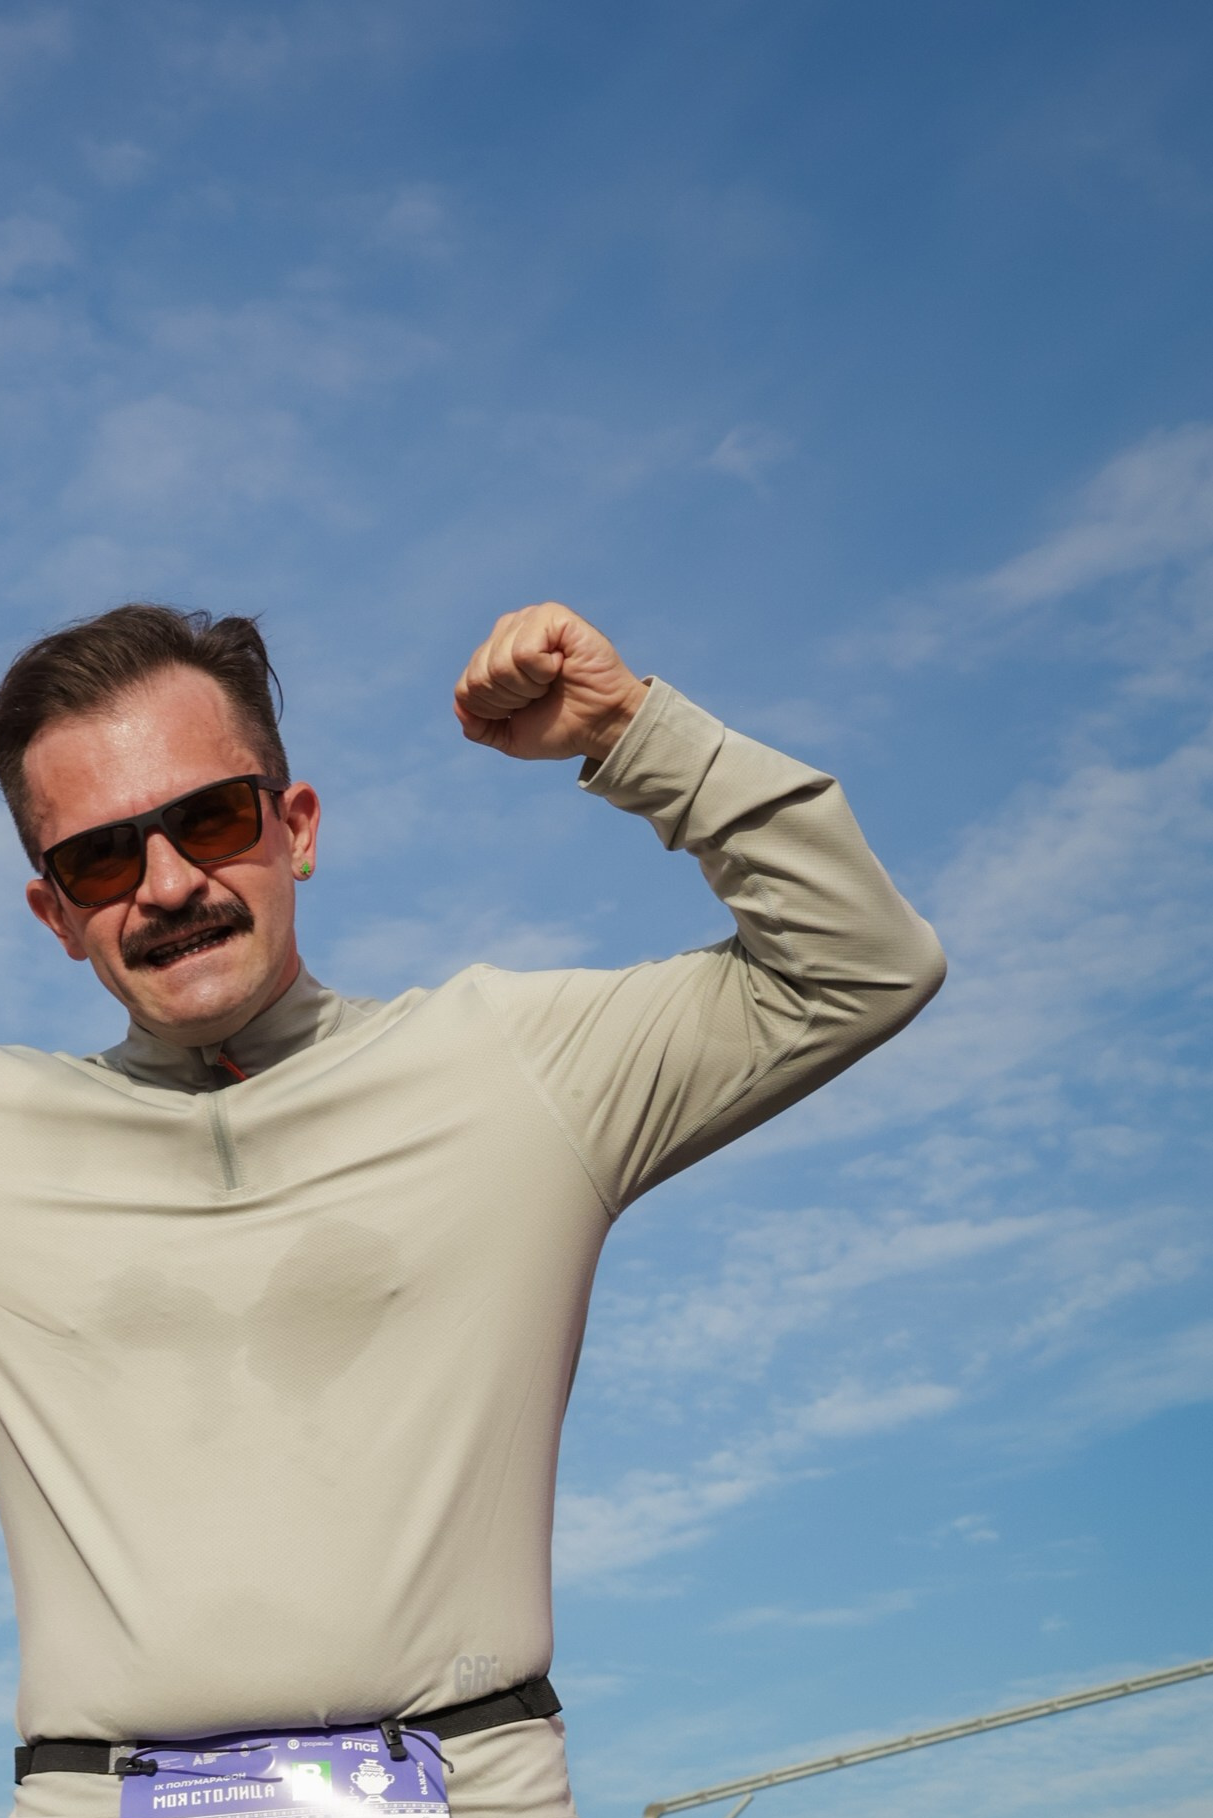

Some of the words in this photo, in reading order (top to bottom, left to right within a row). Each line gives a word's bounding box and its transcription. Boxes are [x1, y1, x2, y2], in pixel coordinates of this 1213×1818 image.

[354, 1741, 379, 1753] ПСБ
[166, 1772, 247, 1790] ПОЛУМАРАФОН
[153, 1792, 188, 1810] МОЯ
[191, 1784, 276, 1806] СТОЛИЦА
